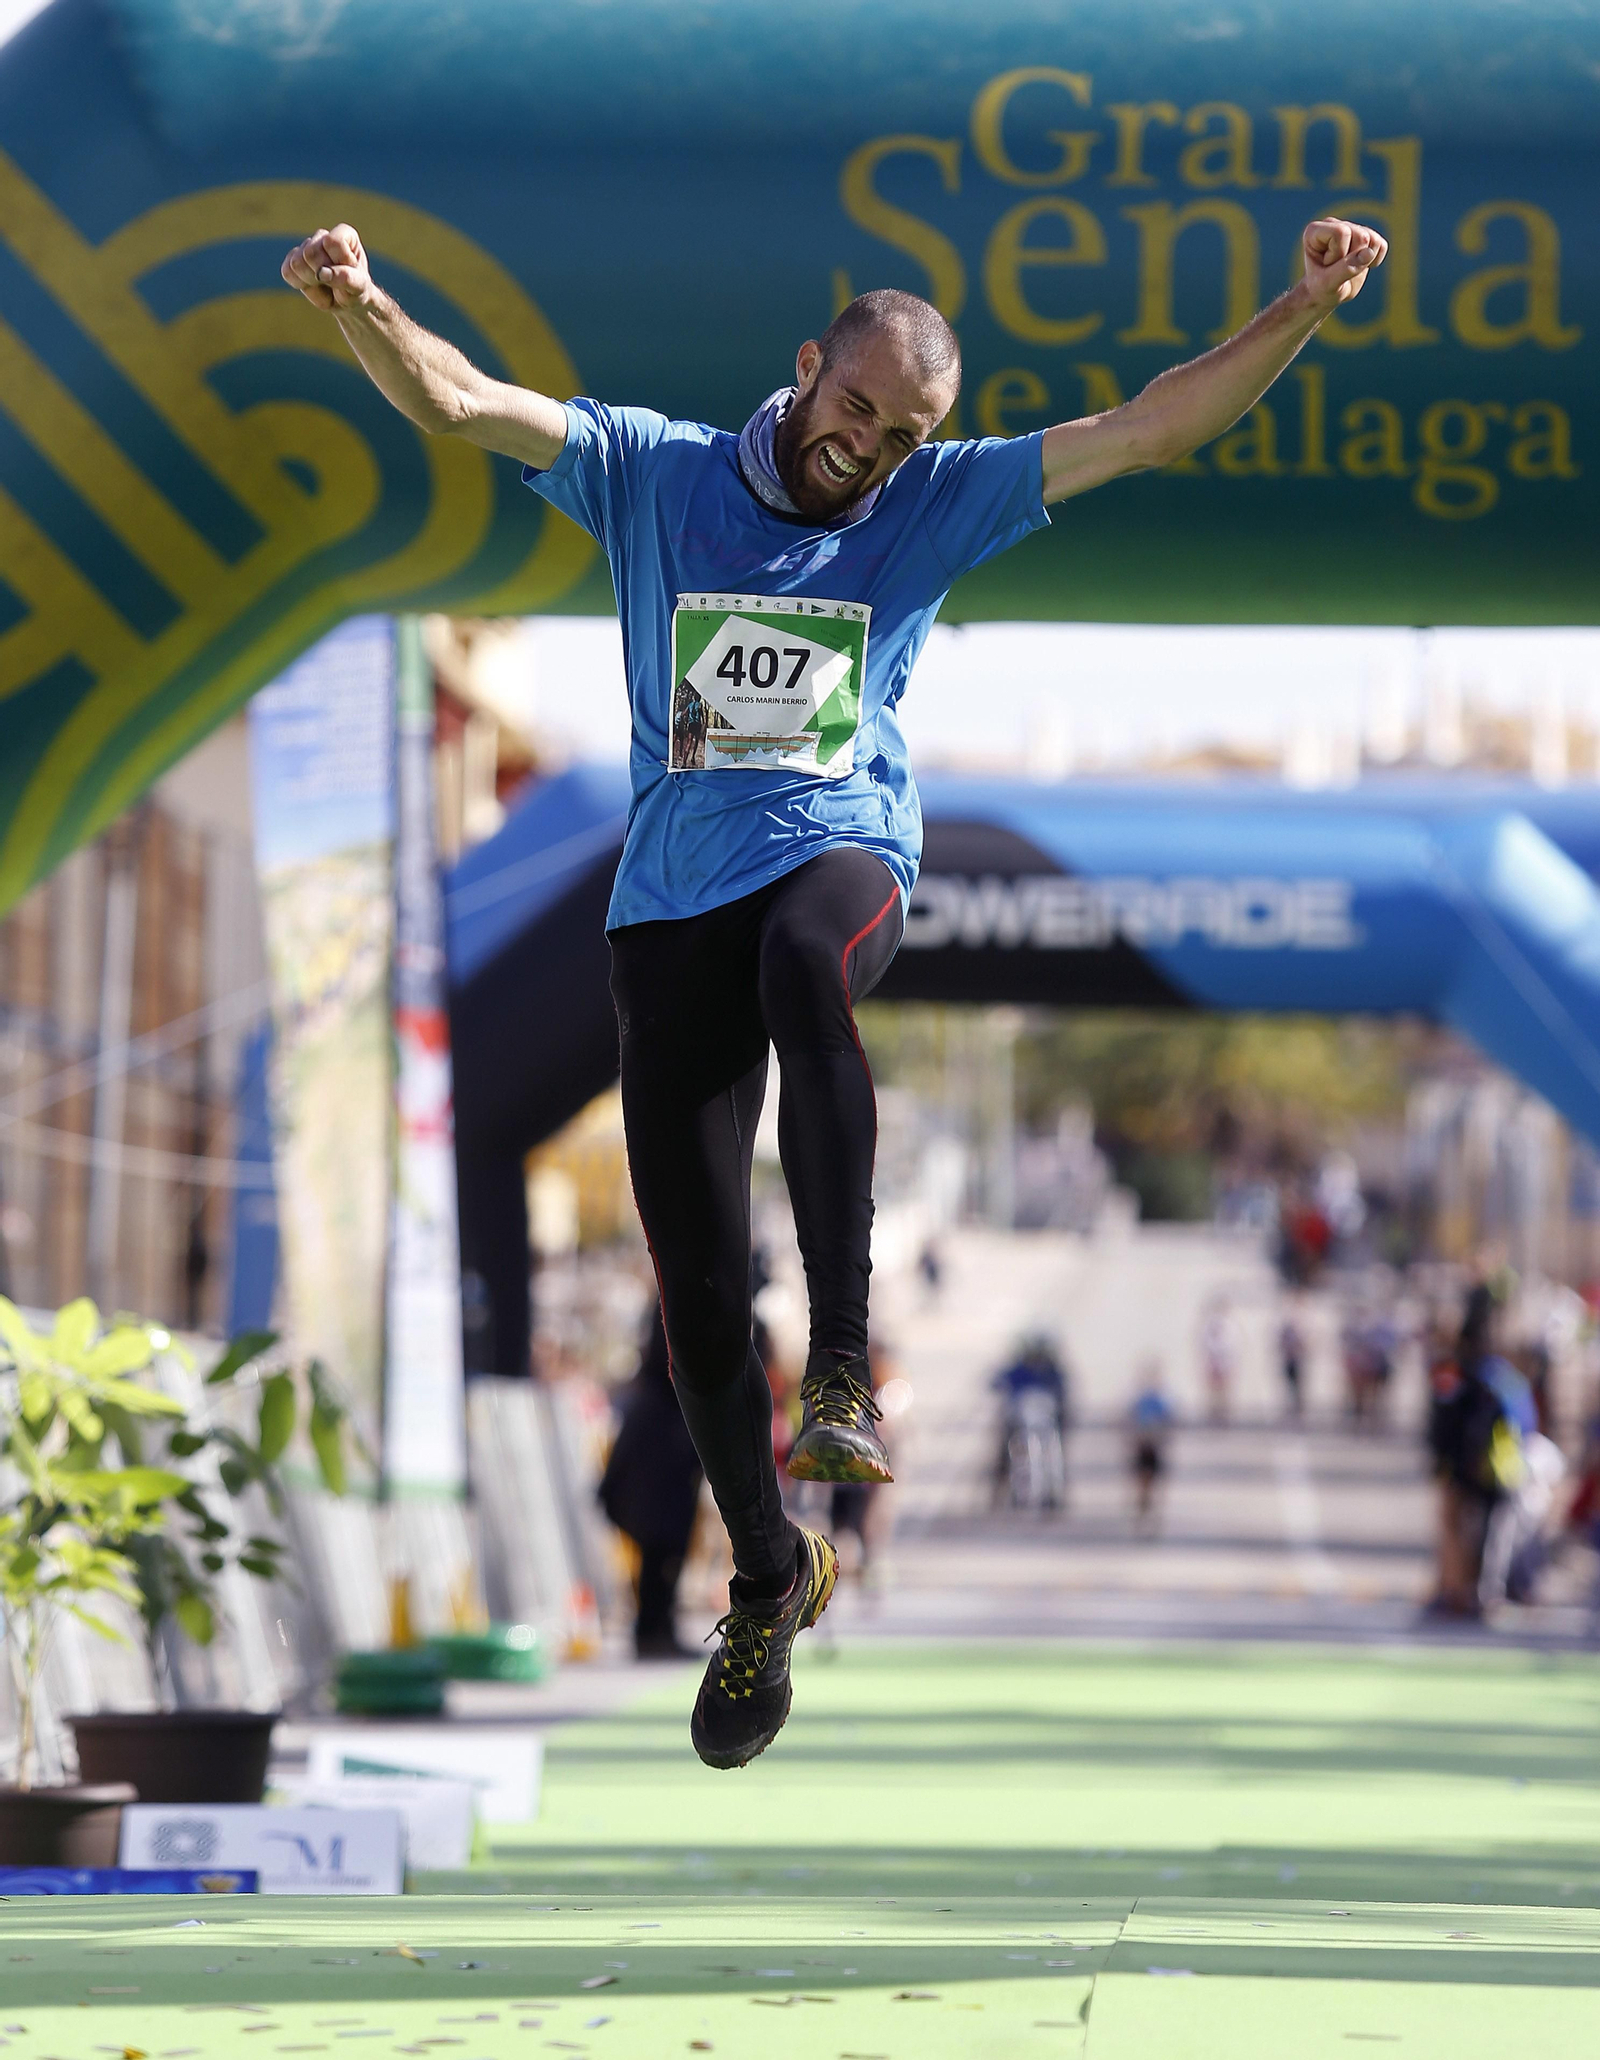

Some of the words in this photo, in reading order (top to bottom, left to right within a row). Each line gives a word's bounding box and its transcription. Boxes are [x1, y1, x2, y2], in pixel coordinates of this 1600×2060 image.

[969, 66, 1370, 190] Gran
[832, 135, 1582, 350] Senda
[716, 645, 811, 689] 407
[726, 695, 755, 704] CARLOS
[755, 696, 781, 705] MARIN
[781, 697, 808, 706] BERRIO
[899, 876, 1356, 950] OWERADE
